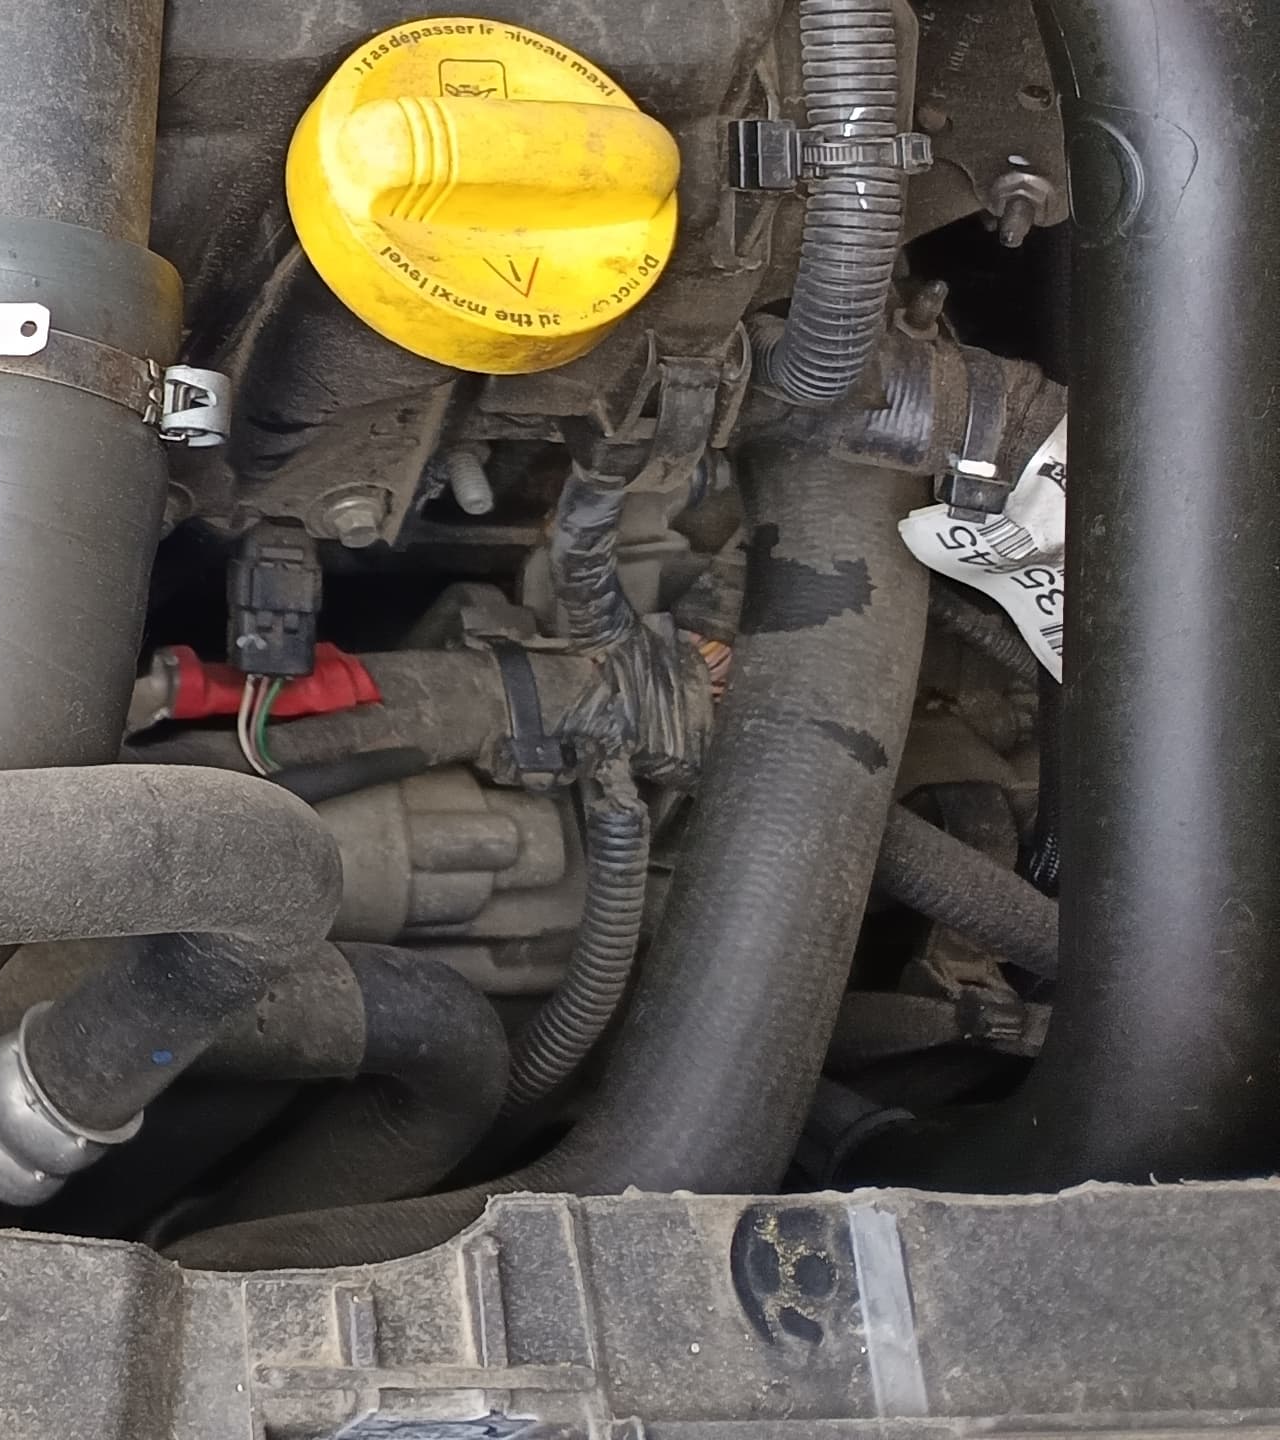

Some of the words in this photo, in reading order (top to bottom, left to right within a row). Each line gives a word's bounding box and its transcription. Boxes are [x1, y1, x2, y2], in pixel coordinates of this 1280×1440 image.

[569, 57, 617, 98] maxi
[378, 244, 428, 290] level
[495, 309, 533, 329] the
